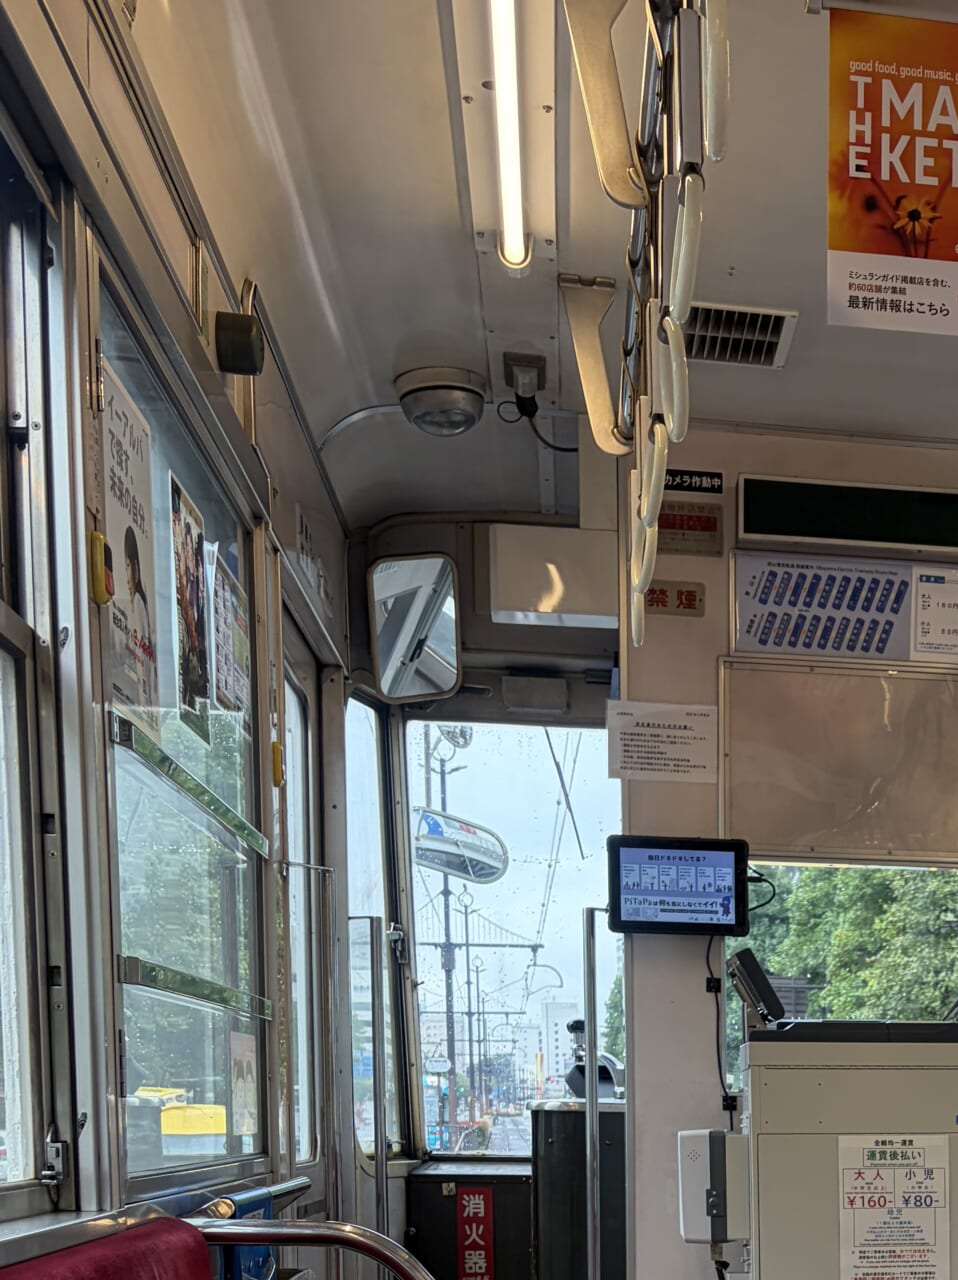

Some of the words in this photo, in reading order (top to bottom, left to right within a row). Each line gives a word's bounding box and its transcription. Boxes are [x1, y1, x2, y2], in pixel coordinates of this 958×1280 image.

[850, 60, 872, 72] good
[900, 65, 922, 78] good
[848, 271, 951, 288] ミシュランガイド掲載店を含む、
[847, 295, 950, 317] 最新情報はこちら
[109, 465, 149, 539] 未来の自分。
[647, 587, 697, 609] 禁煙
[866, 1150, 922, 1161] 運賃後払い
[462, 1194, 487, 1273] 消火器
